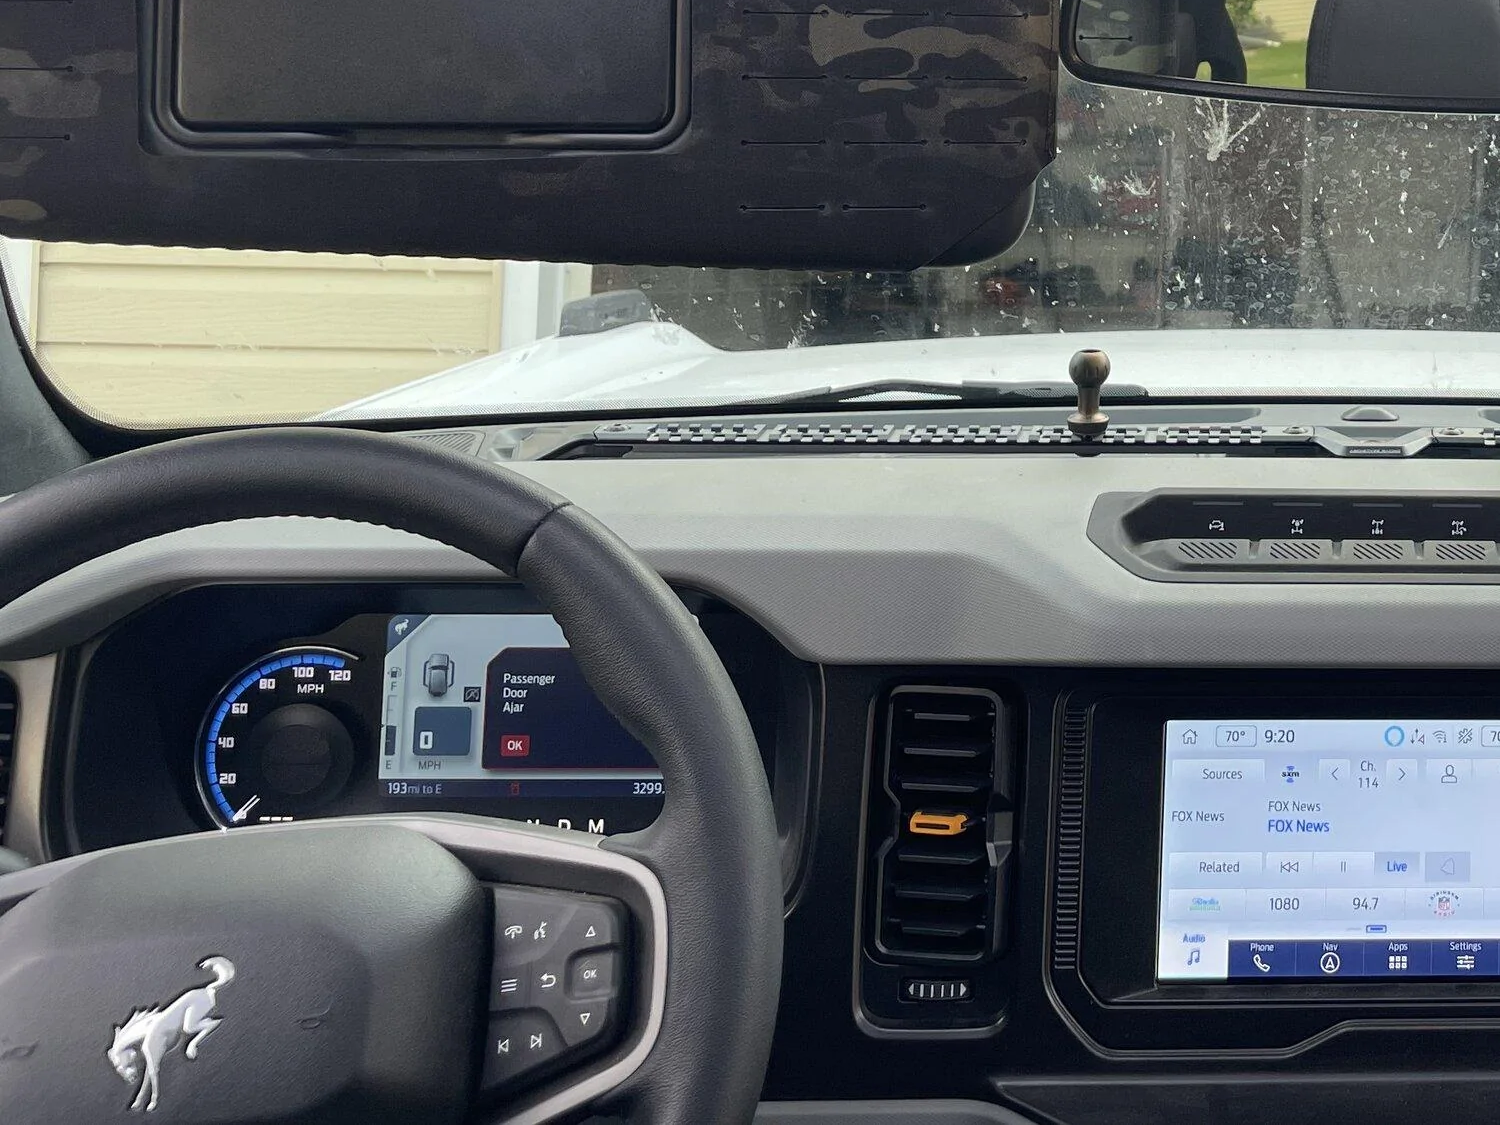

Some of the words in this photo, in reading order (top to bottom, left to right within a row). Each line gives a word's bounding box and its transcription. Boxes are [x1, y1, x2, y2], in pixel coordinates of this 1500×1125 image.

[292, 667, 314, 678] 100
[329, 670, 351, 681] 120
[259, 678, 276, 690] 80
[503, 673, 556, 686] Passenger
[297, 684, 324, 693] MPH
[503, 687, 528, 698] Door
[231, 703, 249, 714] 60
[502, 701, 525, 714] Ajar
[218, 737, 235, 748] 40
[419, 731, 433, 750] 0
[1225, 730, 1246, 743] 70°
[1264, 729, 1295, 744] 9:20
[507, 740, 523, 751] OK
[386, 760, 392, 770] E
[418, 760, 441, 770] MPH
[1360, 760, 1376, 772] Ch.
[219, 773, 237, 785] 20
[1202, 768, 1243, 780] Sources
[422, 783, 433, 794] to
[435, 783, 442, 794] E
[1358, 777, 1379, 789] 114
[1268, 801, 1289, 812] FOX
[1291, 801, 1321, 812] News
[1172, 811, 1193, 822] FOX
[1195, 811, 1225, 822] News
[588, 819, 605, 834] M
[1268, 819, 1293, 833] FOX
[1296, 819, 1330, 833] News
[1199, 861, 1240, 873] Related
[1386, 861, 1408, 873] Live
[1269, 897, 1300, 911] 1080
[1352, 897, 1379, 911] 94.7
[1182, 934, 1206, 944] Audio
[1250, 942, 1275, 952] Phone
[1323, 942, 1339, 952] Nav
[1388, 942, 1409, 954] Apps
[1449, 941, 1482, 953] Settings
[583, 970, 597, 979] OK
